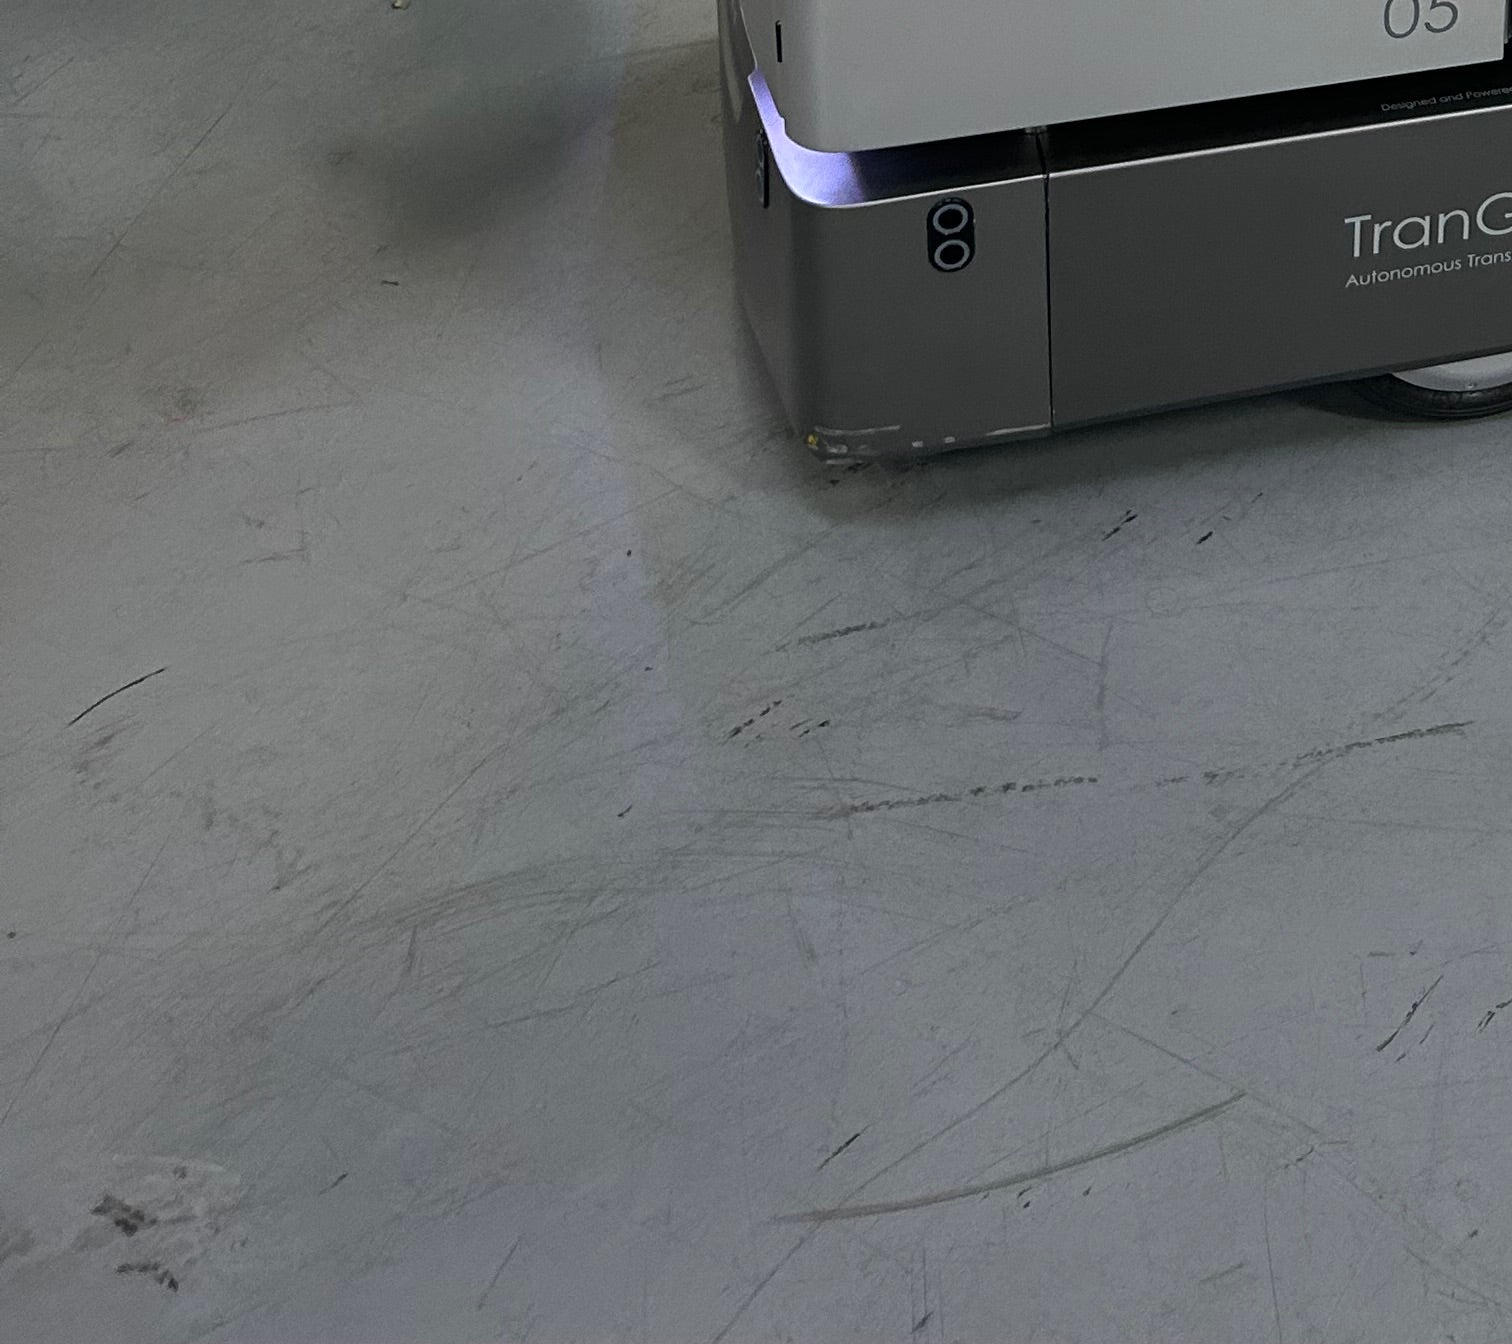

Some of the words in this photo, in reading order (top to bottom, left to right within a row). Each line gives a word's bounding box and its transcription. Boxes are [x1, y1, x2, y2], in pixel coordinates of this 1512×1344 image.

[1380, 96, 1437, 112] Designed
[1438, 91, 1464, 103] and
[1344, 258, 1462, 289] Autonomous
